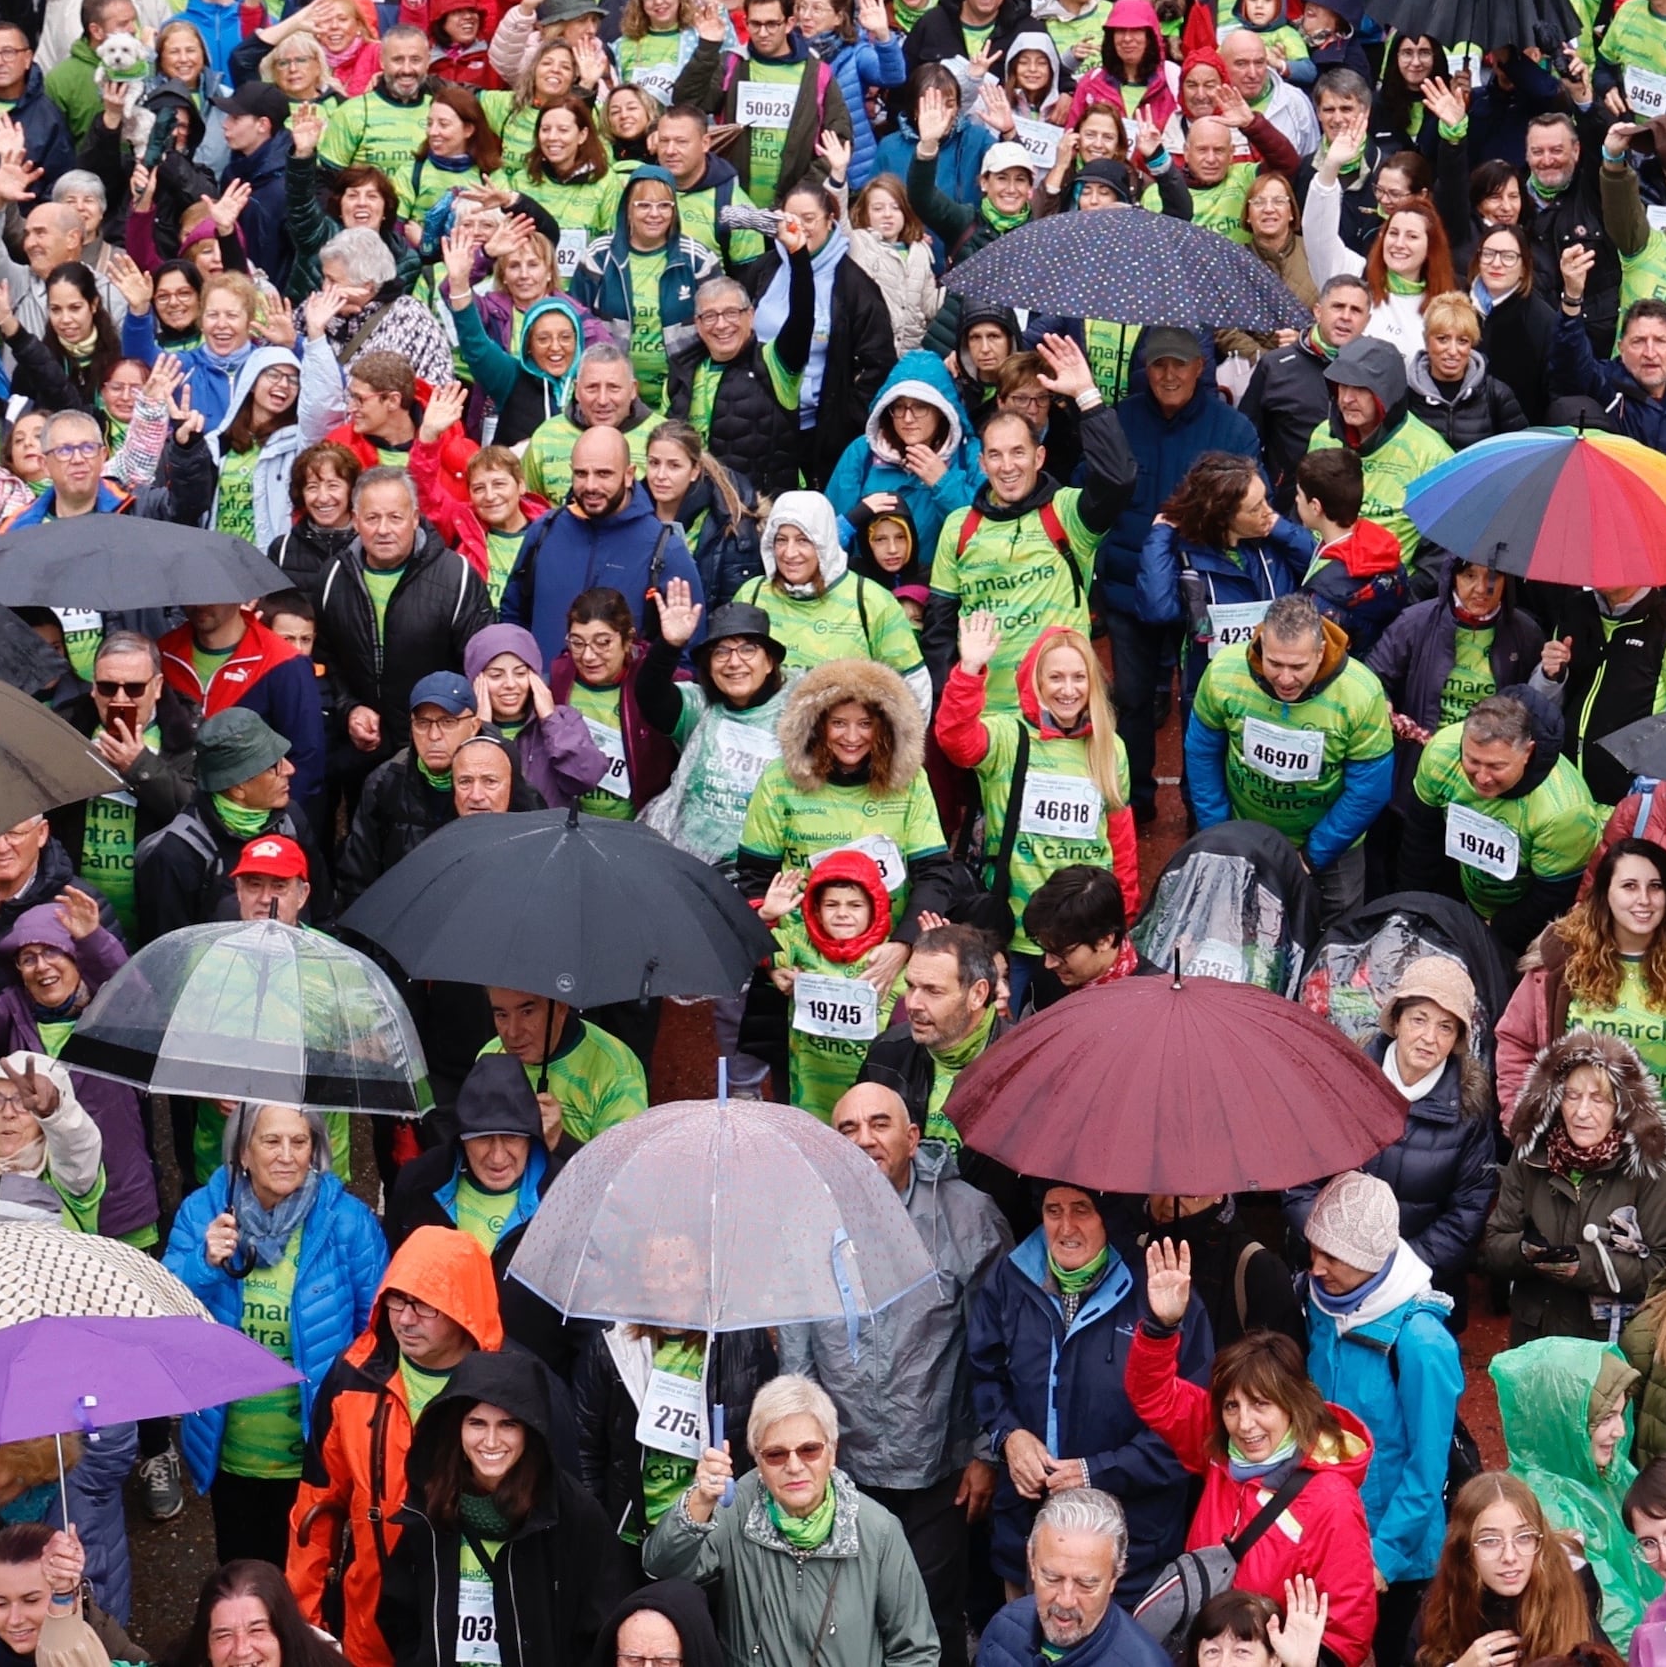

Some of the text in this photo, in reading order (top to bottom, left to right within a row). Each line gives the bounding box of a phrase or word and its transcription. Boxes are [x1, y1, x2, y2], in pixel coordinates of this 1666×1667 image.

[744, 99, 791, 118] 50023
[1630, 85, 1663, 108] 9458
[974, 562, 1057, 592] marcha
[1252, 742, 1310, 771] 46970
[1035, 799, 1090, 825] 46818
[1459, 829, 1507, 865] 19744
[807, 997, 861, 1026] 19745
